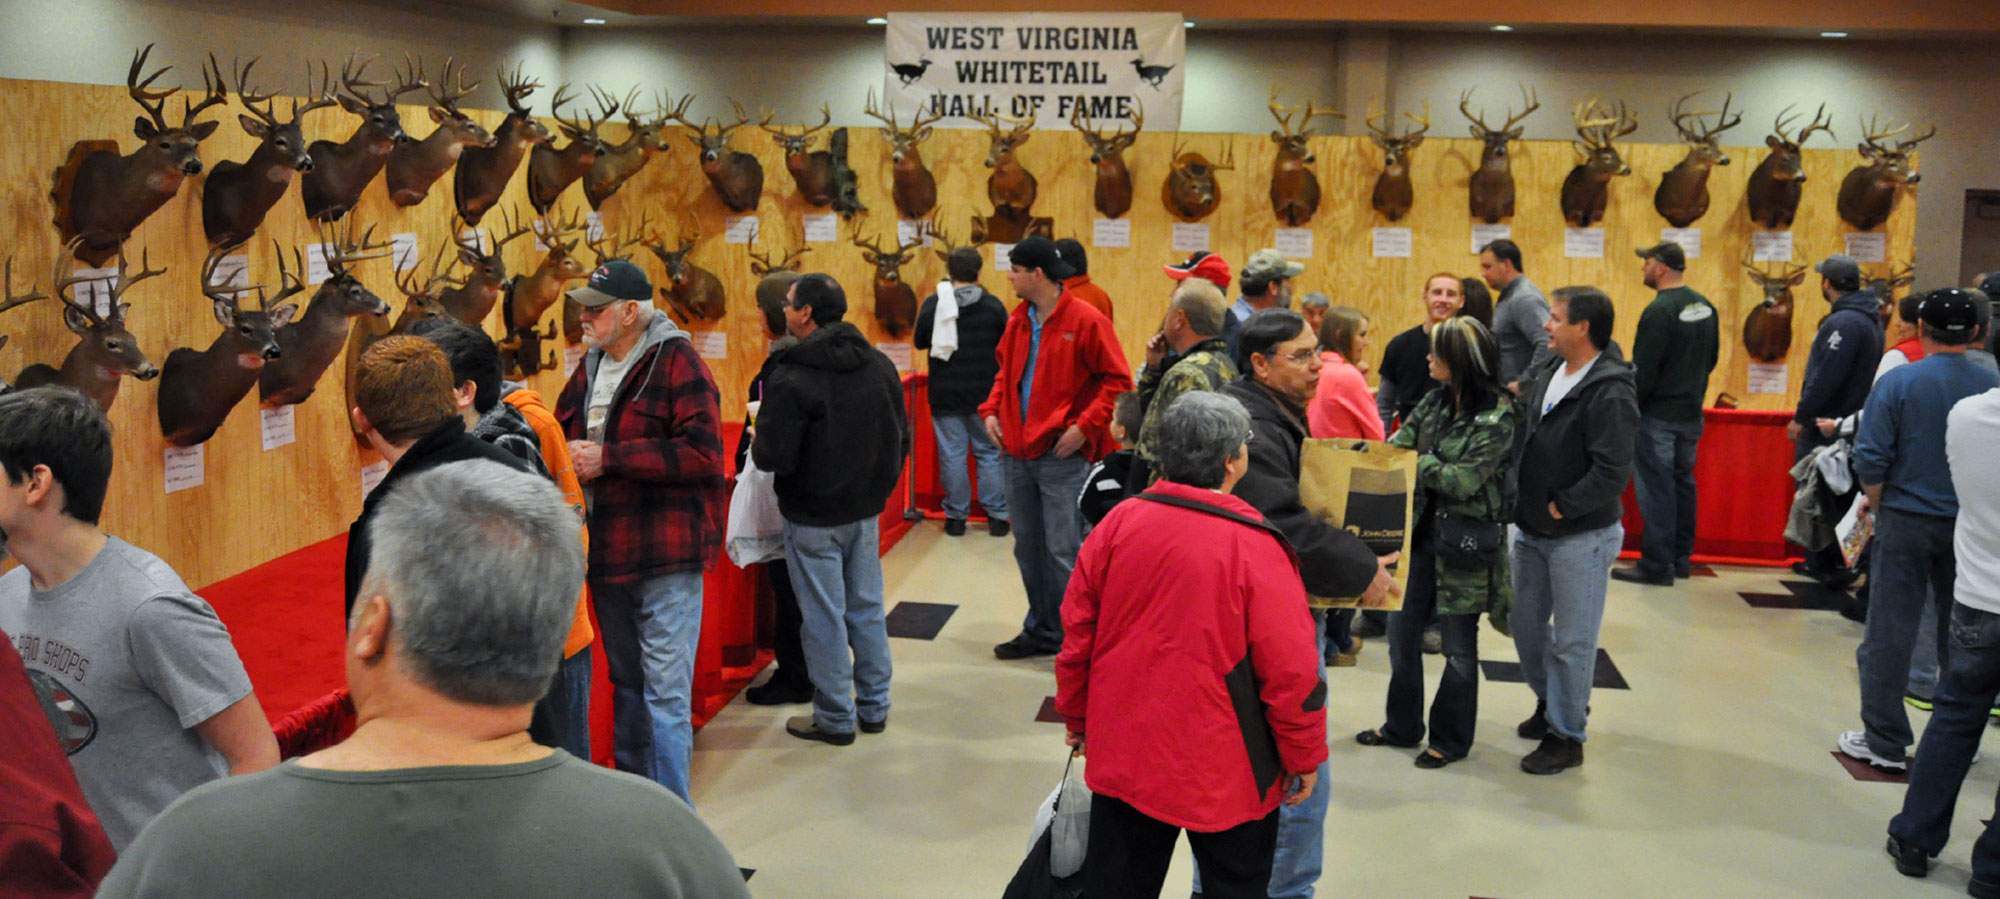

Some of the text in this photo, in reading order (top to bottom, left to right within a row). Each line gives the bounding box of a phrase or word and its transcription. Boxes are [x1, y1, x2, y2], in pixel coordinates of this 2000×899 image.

[926, 27, 1139, 49] WEST VIRGINIA
[955, 61, 1107, 84] WHITETAIL
[931, 94, 1132, 119] HALL OF FAME
[44, 640, 89, 682] SHOPS
